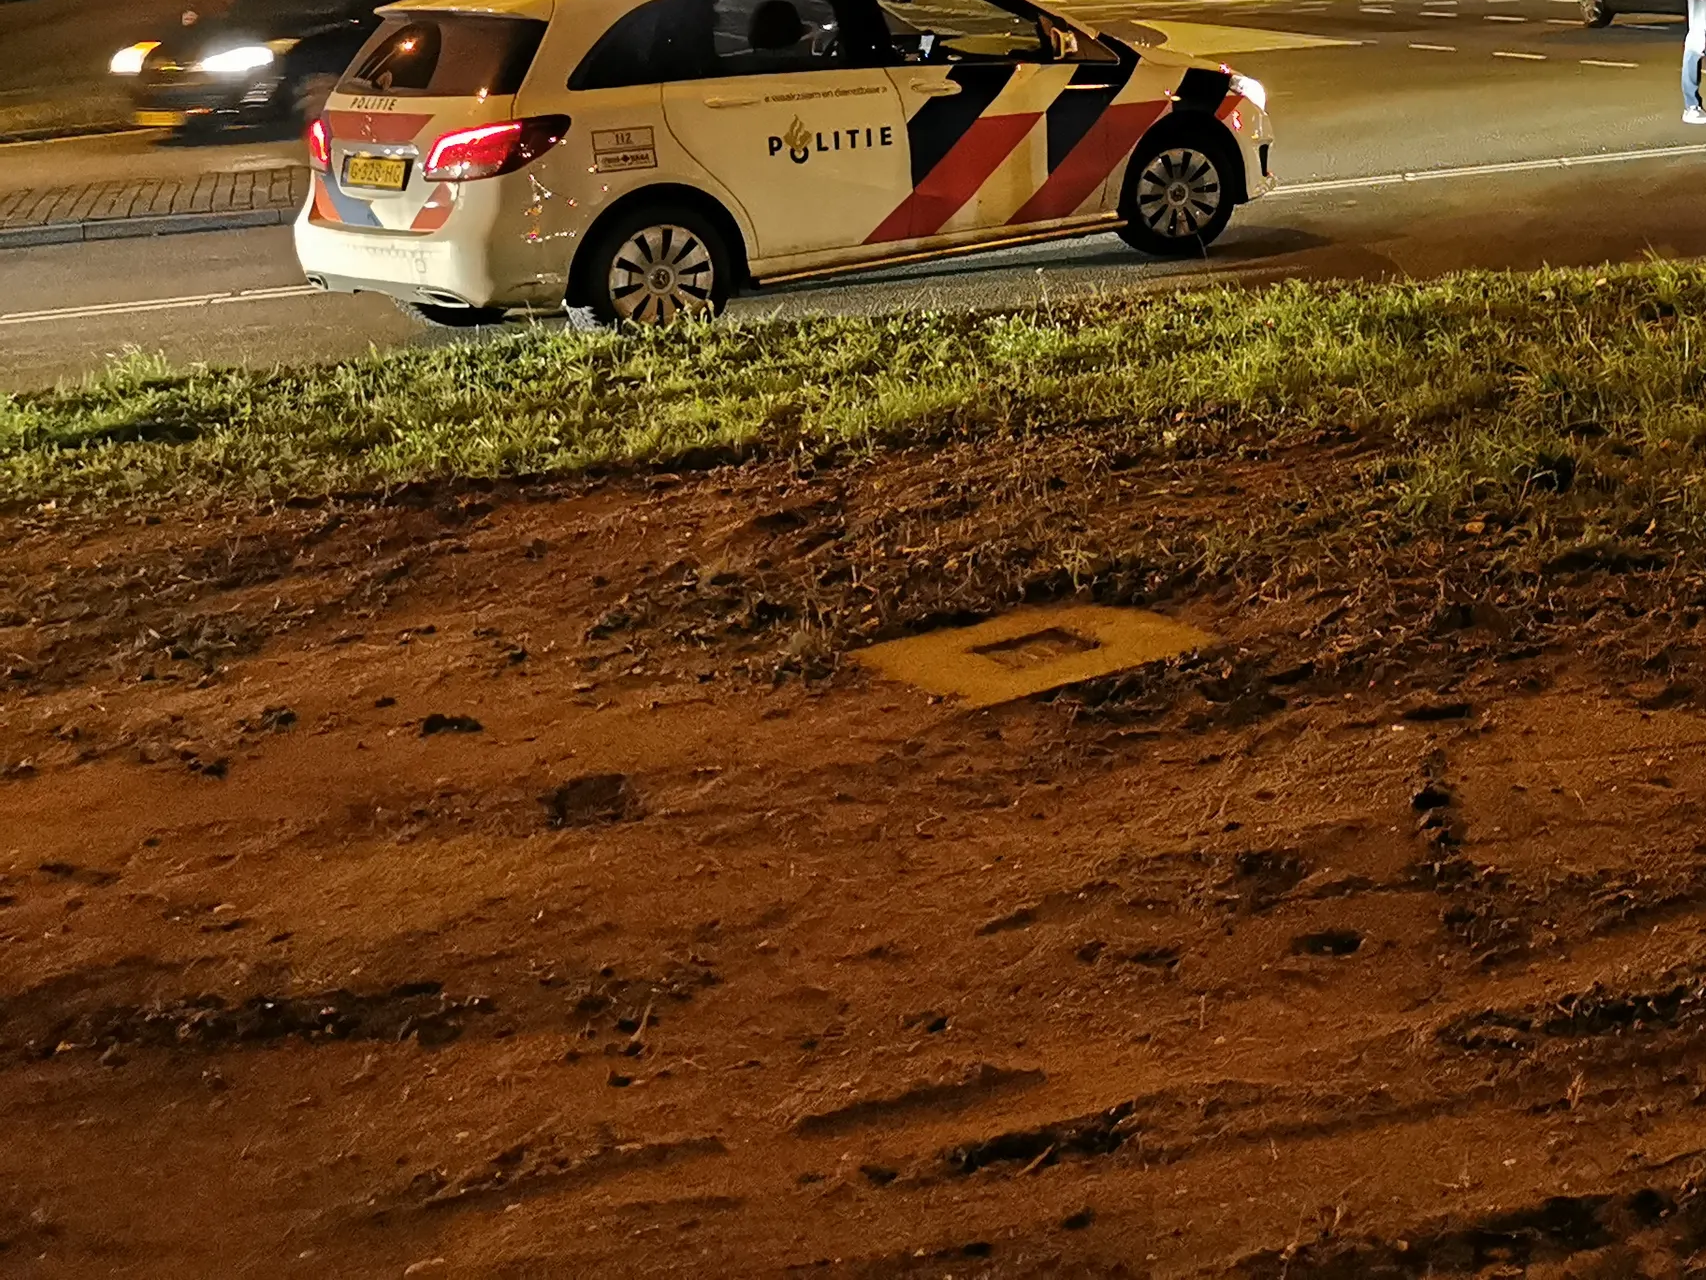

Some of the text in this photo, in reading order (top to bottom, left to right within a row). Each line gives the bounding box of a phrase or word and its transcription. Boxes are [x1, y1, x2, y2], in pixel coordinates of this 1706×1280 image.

[350, 97, 397, 111] POLITIE
[615, 132, 634, 145] 112
[768, 126, 893, 164] POLITIE
